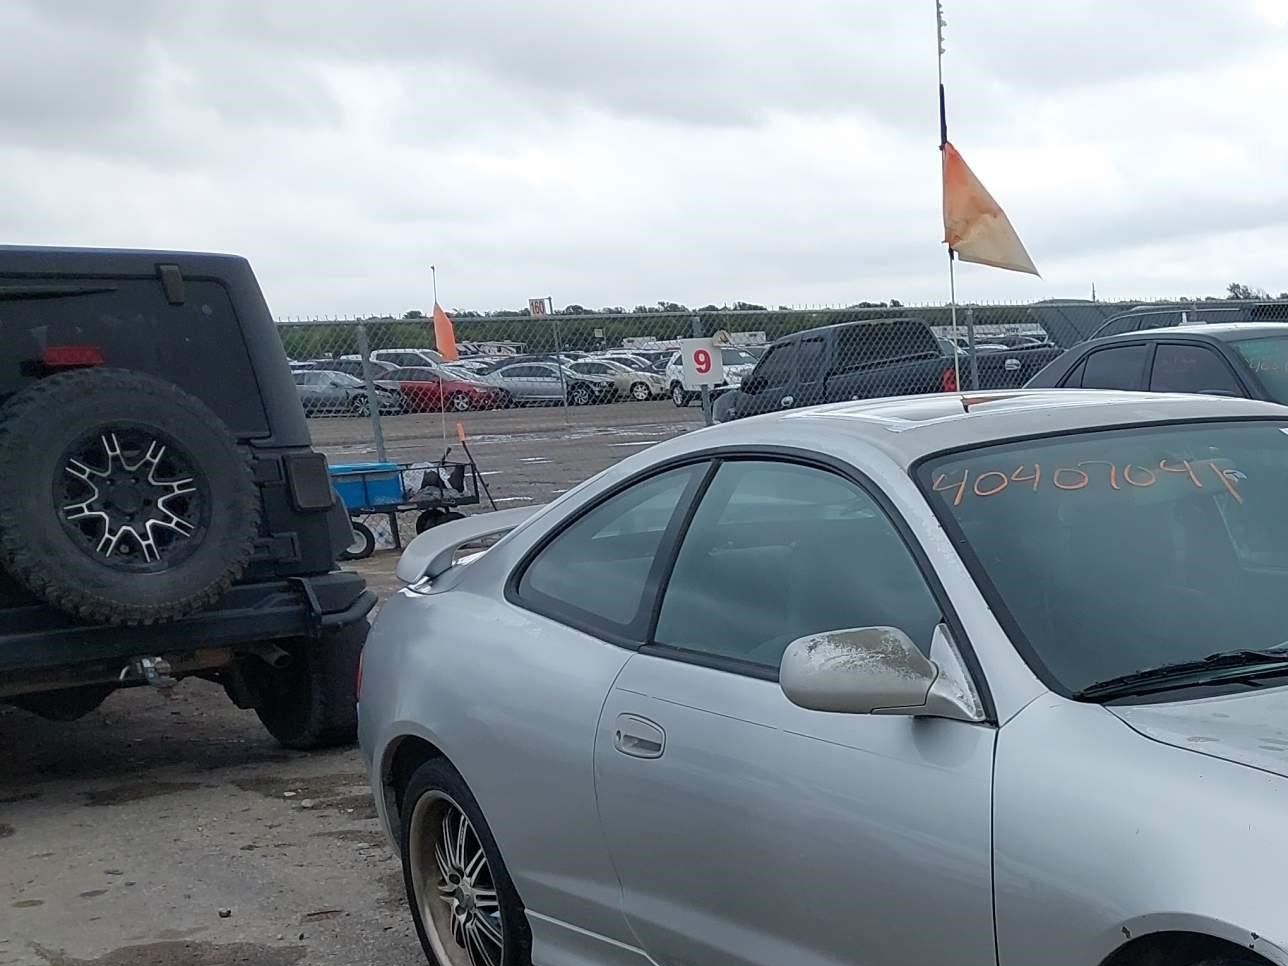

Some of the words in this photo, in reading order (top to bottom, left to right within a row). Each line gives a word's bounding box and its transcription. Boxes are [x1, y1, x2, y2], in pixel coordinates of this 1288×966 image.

[530, 301, 545, 314] 160
[694, 350, 711, 374] 9
[932, 460, 1243, 505] 40407041
